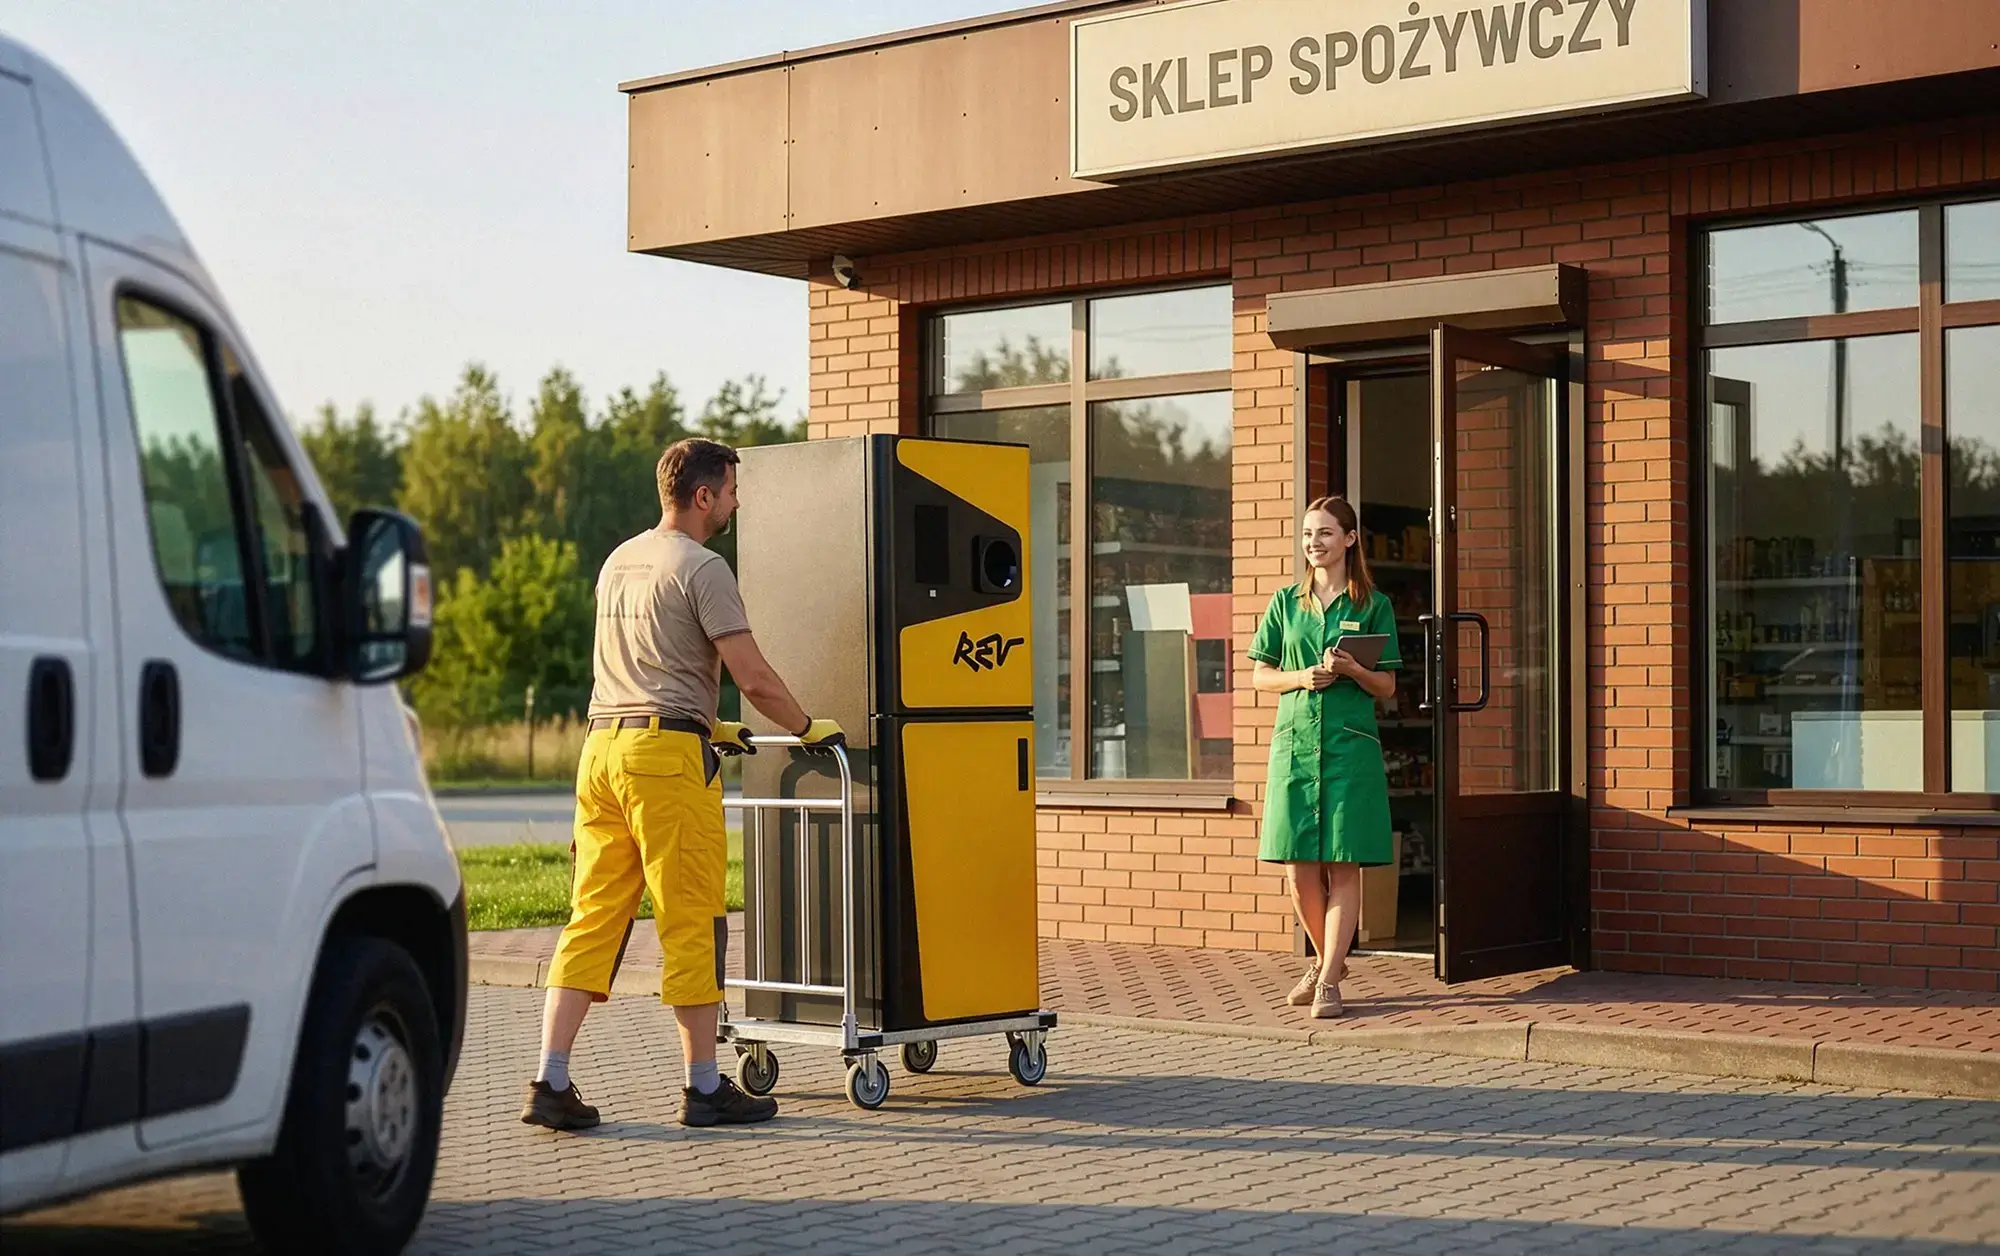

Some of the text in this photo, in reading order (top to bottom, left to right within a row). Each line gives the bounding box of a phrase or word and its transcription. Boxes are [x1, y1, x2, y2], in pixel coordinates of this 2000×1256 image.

[1109, 0, 1637, 122] SKLEP SPOŻYWCZY
[952, 630, 1025, 673] REV
